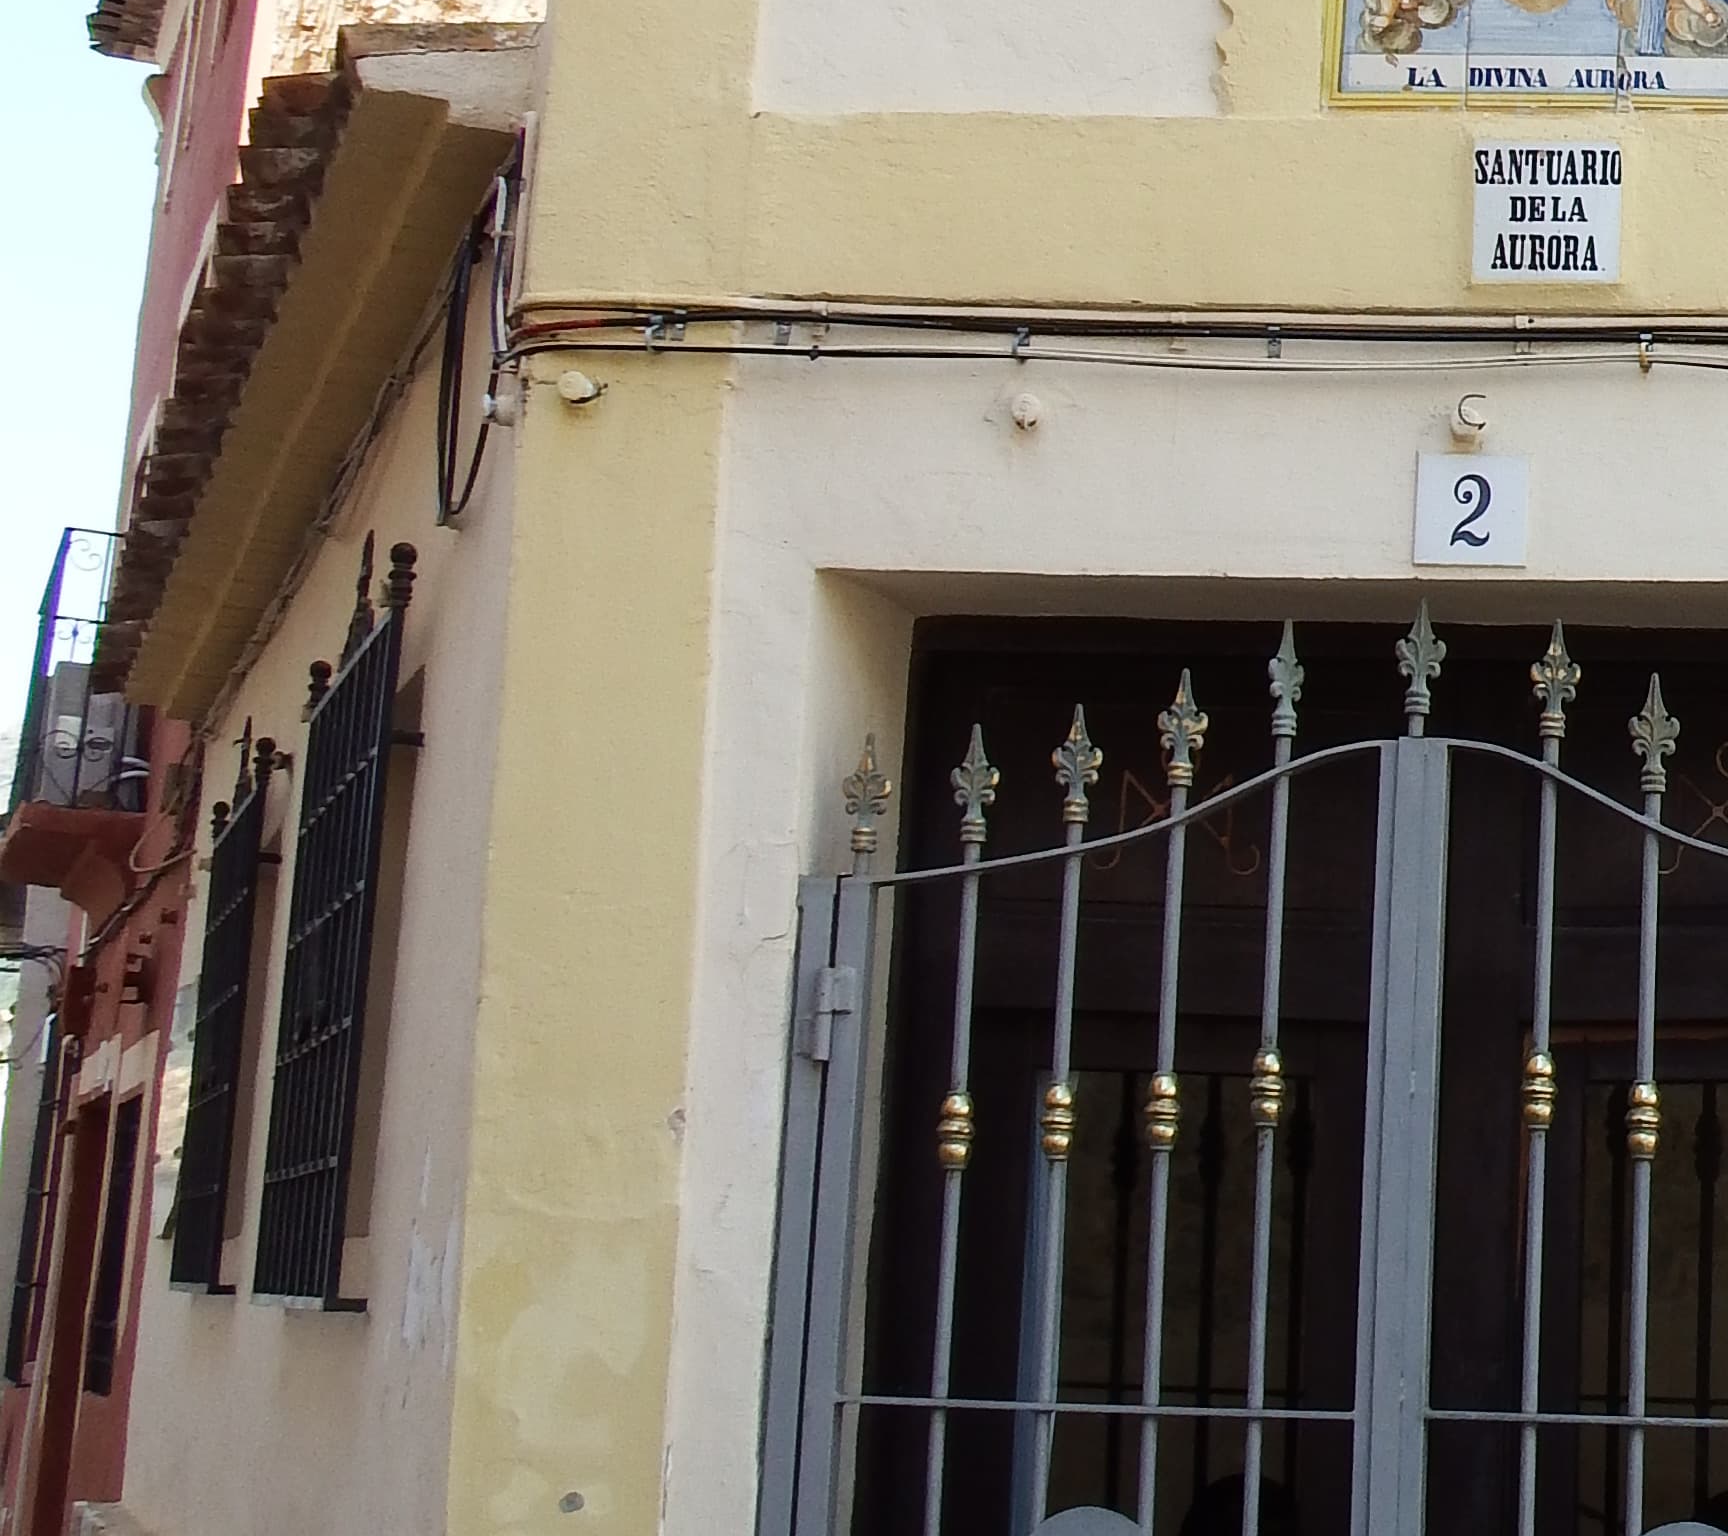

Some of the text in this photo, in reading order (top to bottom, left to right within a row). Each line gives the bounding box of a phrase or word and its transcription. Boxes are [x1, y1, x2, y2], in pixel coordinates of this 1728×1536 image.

[1408, 67, 1671, 91] LA DIVINA AURORA
[1474, 149, 1622, 185] SANTUARIO
[1509, 196, 1588, 222] DE LA
[1490, 233, 1599, 272] AURORA
[1450, 474, 1491, 547] 2
